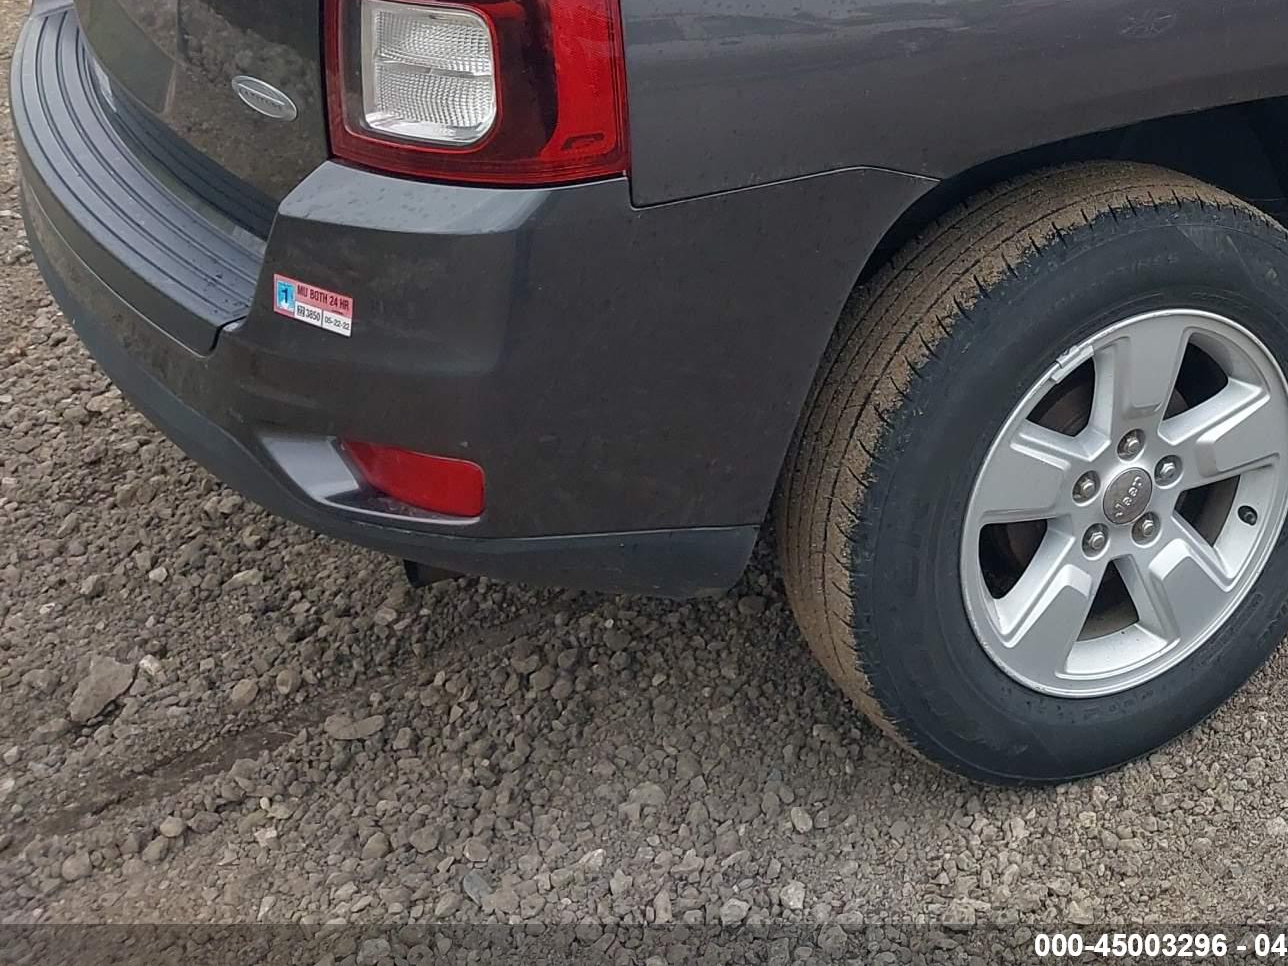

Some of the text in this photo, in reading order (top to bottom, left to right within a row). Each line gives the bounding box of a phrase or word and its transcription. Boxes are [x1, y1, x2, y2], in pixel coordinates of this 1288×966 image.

[309, 288, 328, 304] BOTH
[329, 295, 338, 308] 24
[1113, 475, 1144, 519] Jeep
